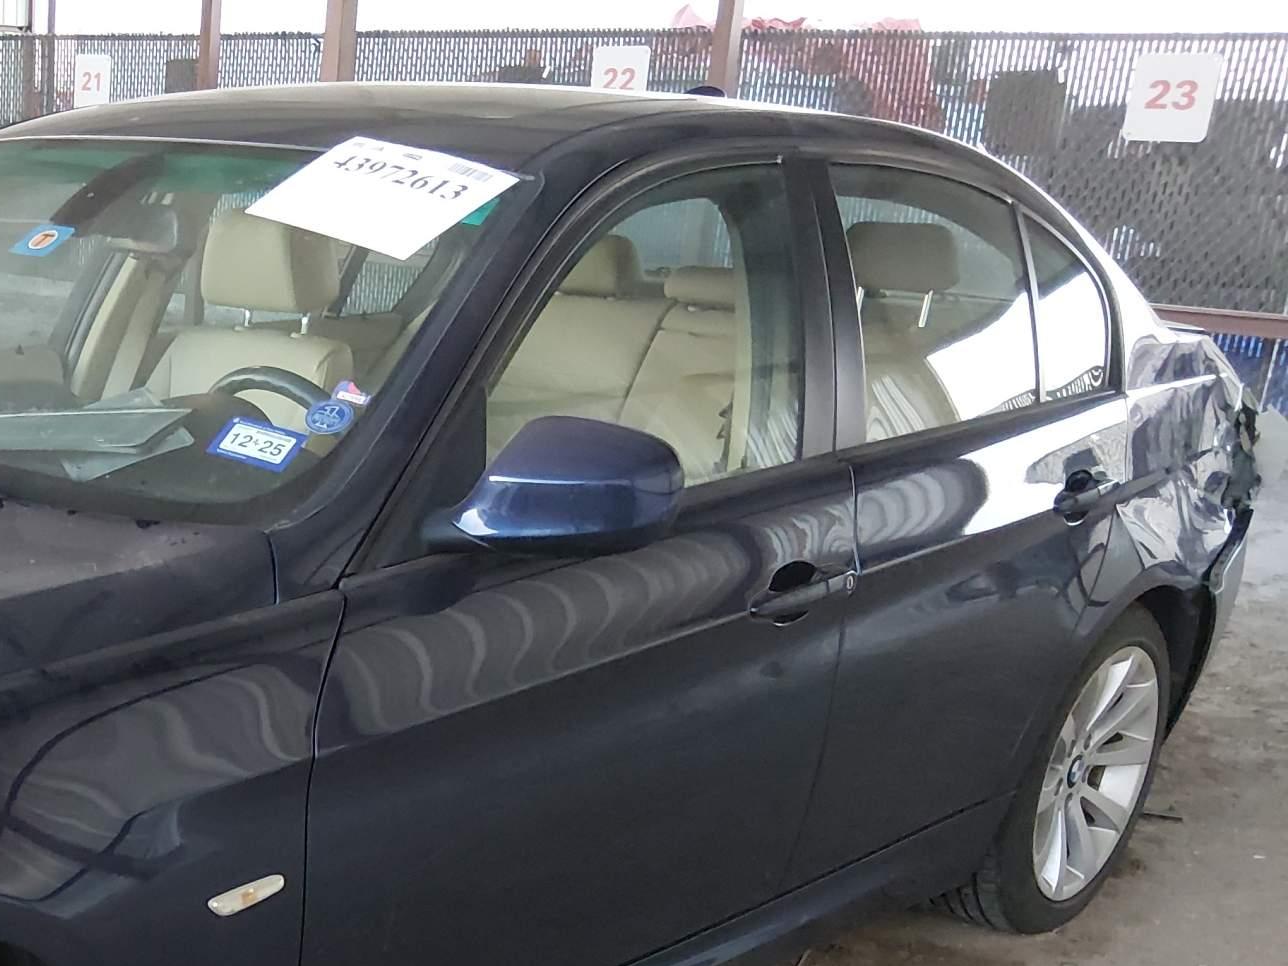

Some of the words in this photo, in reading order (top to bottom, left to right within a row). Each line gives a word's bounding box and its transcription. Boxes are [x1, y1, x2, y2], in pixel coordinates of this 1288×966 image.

[82, 71, 102, 92] 21
[603, 67, 636, 90] 22
[1144, 79, 1199, 111] 23
[333, 155, 469, 201] 43972613
